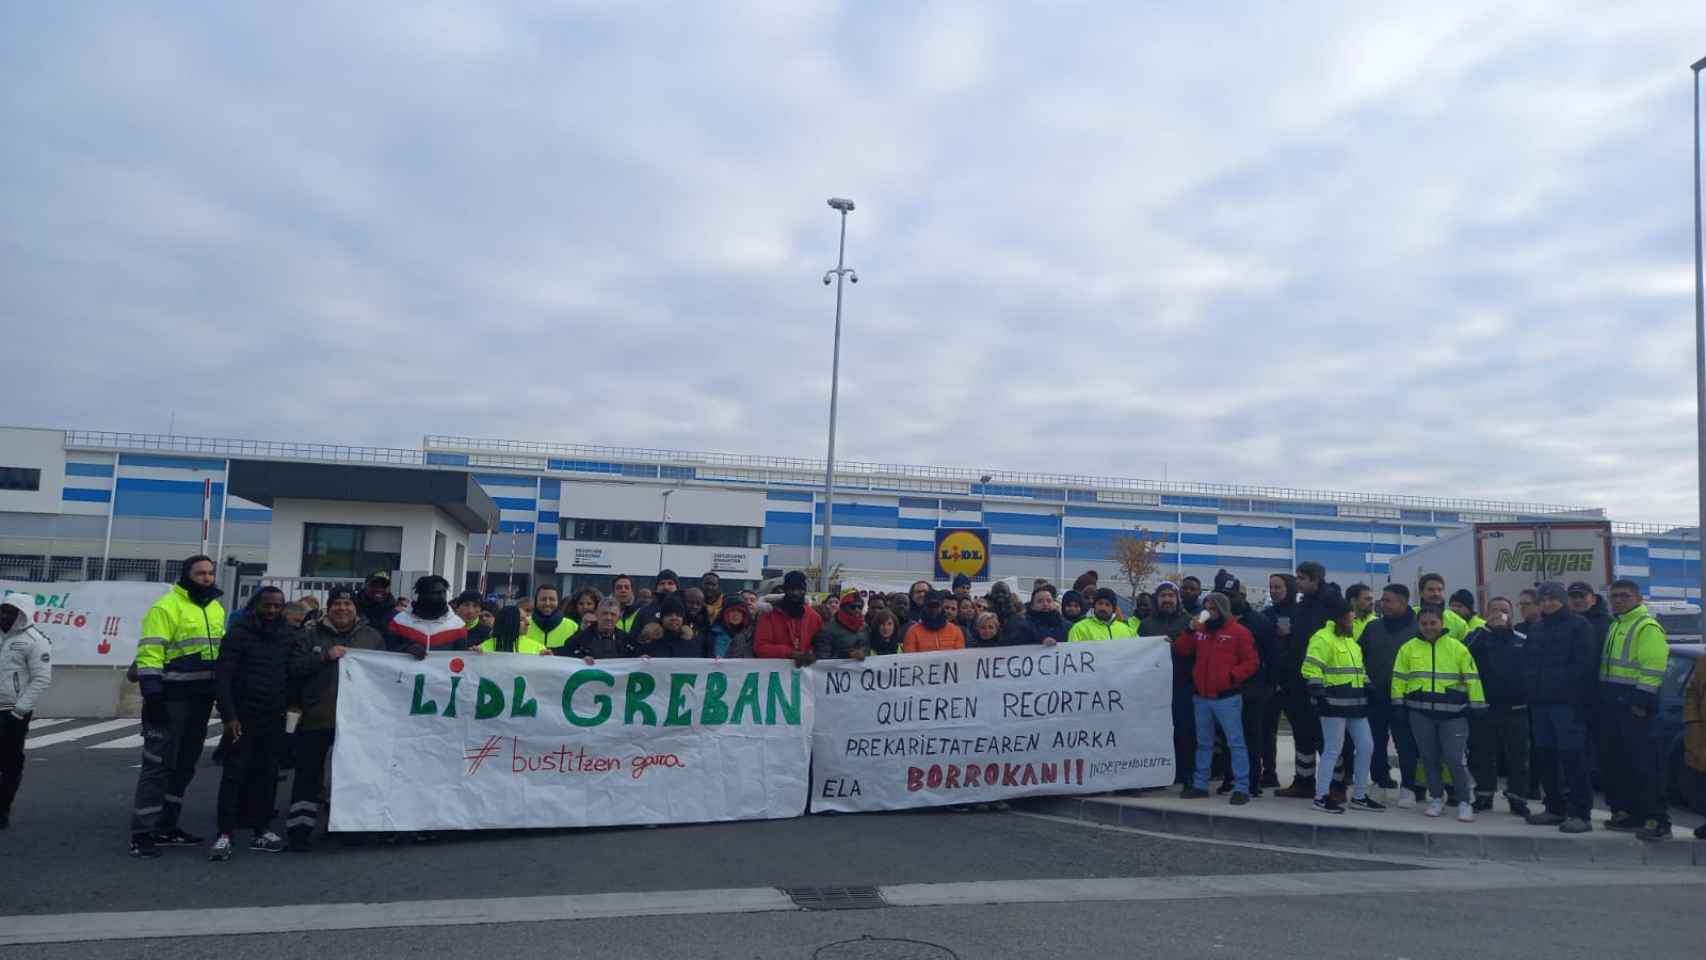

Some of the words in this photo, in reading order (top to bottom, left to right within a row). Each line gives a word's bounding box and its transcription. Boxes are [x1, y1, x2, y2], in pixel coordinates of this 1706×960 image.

[1495, 541, 1594, 576] Navajas
[825, 670, 850, 695] NO
[561, 668, 801, 727] GREBAN
[1003, 690, 1124, 718] RECORTAR
[1052, 730, 1116, 749] AURKA
[511, 735, 621, 774] bustitzen
[822, 779, 861, 798] ELA
